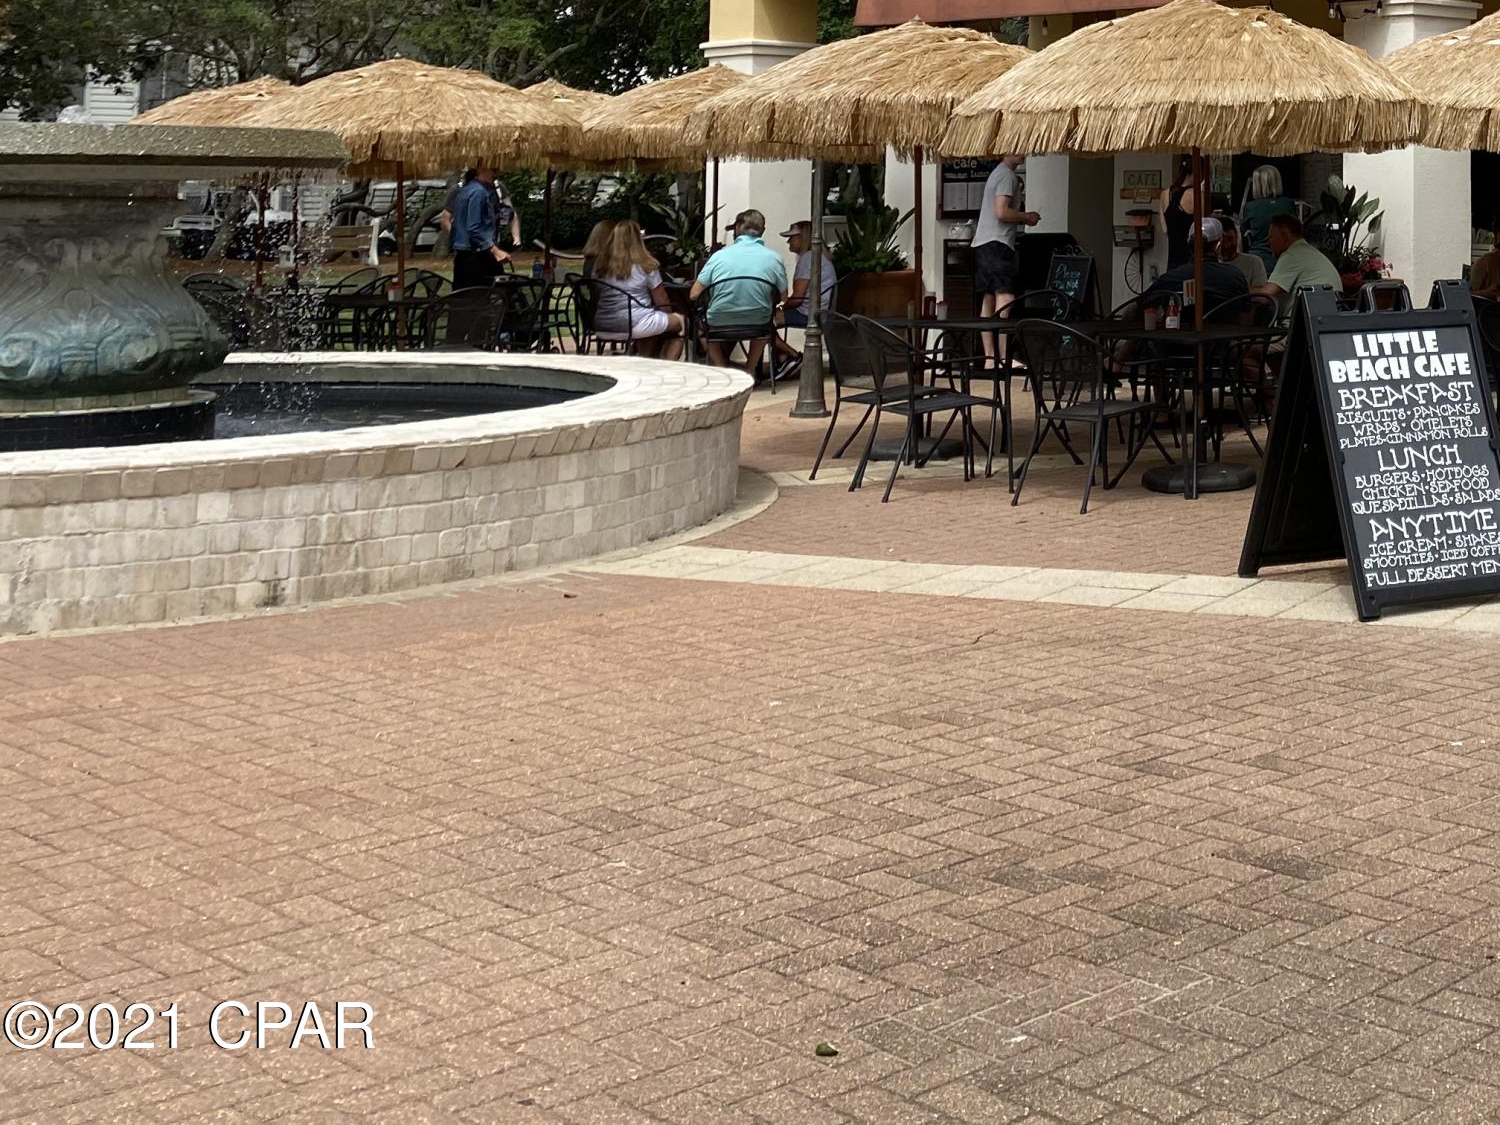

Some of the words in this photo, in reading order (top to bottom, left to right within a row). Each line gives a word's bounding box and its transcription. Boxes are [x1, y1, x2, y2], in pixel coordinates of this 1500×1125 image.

[1127, 173, 1158, 186] CAFE
[1352, 330, 1439, 357] LITTLE
[1328, 356, 1410, 383] BEACH
[1413, 353, 1471, 377] CAFE
[1338, 381, 1474, 410] BREAKFAST
[1337, 408, 1406, 425] BISCUITS
[1413, 403, 1480, 419] PANCAKES
[1351, 421, 1400, 437] WRAPS
[1410, 415, 1473, 431] OMELETS
[1340, 435, 1384, 449] PLATES
[1386, 430, 1451, 444] CINNAMON
[1454, 426, 1489, 439] ROLLS
[1377, 443, 1463, 472] LUNCH
[1355, 470, 1421, 489] BURGERS
[1425, 464, 1490, 483] HOTDOGS
[1362, 482, 1426, 501] CHICKEN
[1429, 476, 1490, 494] SEAFOOD
[1352, 492, 1450, 515] QUESADILLAS
[1369, 507, 1498, 542] ANYTIME
[1363, 552, 1435, 569] SMOOTHIES
[1440, 548, 1469, 562] ICED
[1369, 541, 1396, 558] ICE
[1398, 536, 1447, 555] CREAM
[1365, 571, 1407, 588] FULL
[1407, 563, 1469, 583] DESSERT
